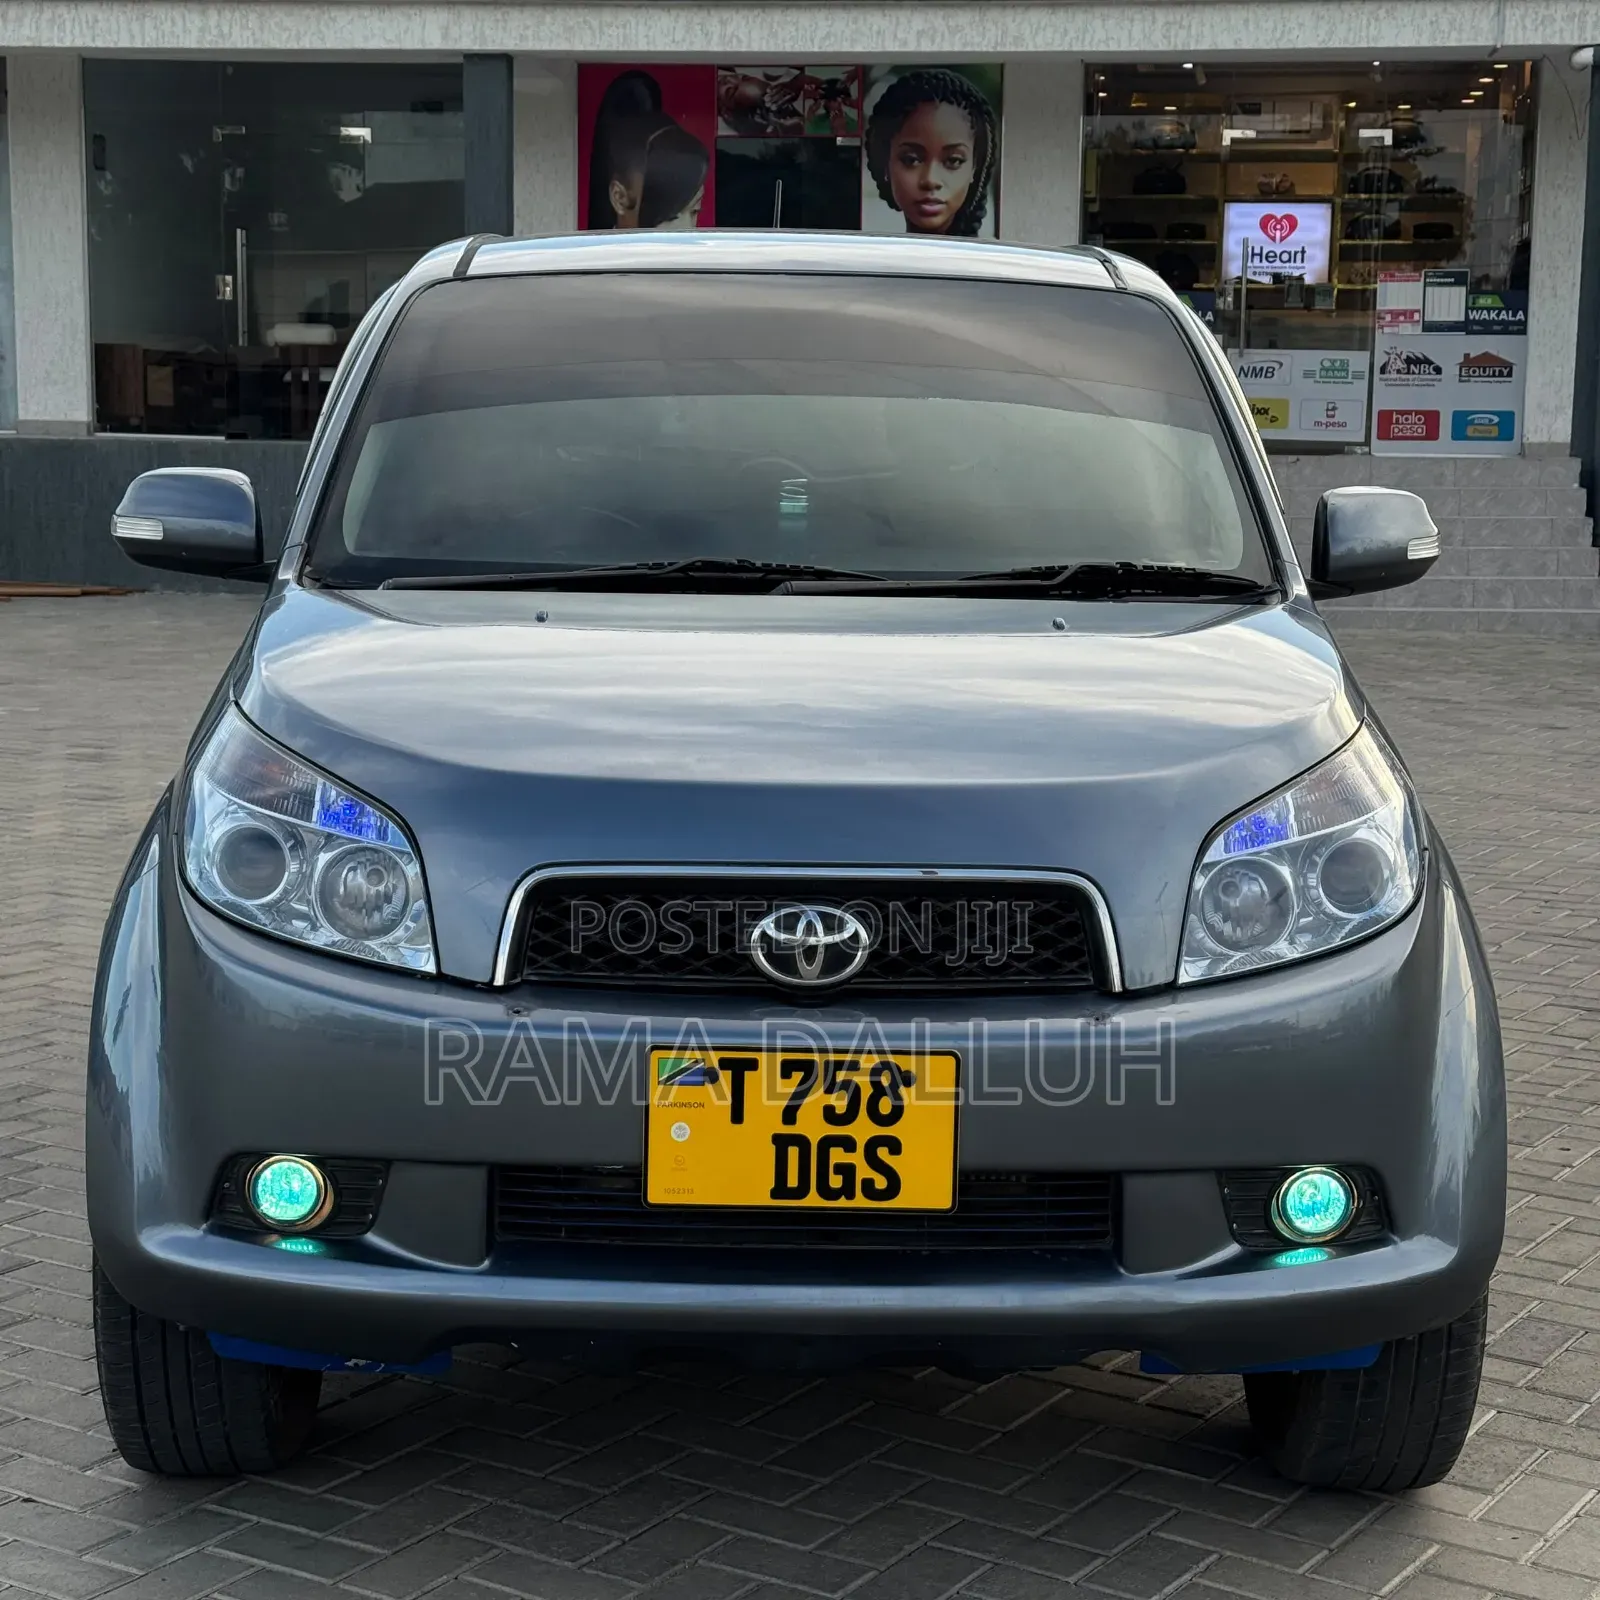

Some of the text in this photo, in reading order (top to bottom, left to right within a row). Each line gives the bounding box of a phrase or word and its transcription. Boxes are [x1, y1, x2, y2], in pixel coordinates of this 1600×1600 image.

[1248, 245, 1307, 264] Heart
[1468, 309, 1525, 321] WAKALA
[1238, 365, 1276, 379] NMB
[1410, 363, 1437, 375] NBC
[1461, 367, 1510, 376] EQUITY
[1393, 411, 1425, 424] halo
[1313, 420, 1347, 429] m-pesa
[1391, 425, 1426, 438] pesa
[718, 1057, 905, 1128] T 758
[656, 1101, 705, 1109] PARKINSON
[770, 1133, 903, 1202] DGS
